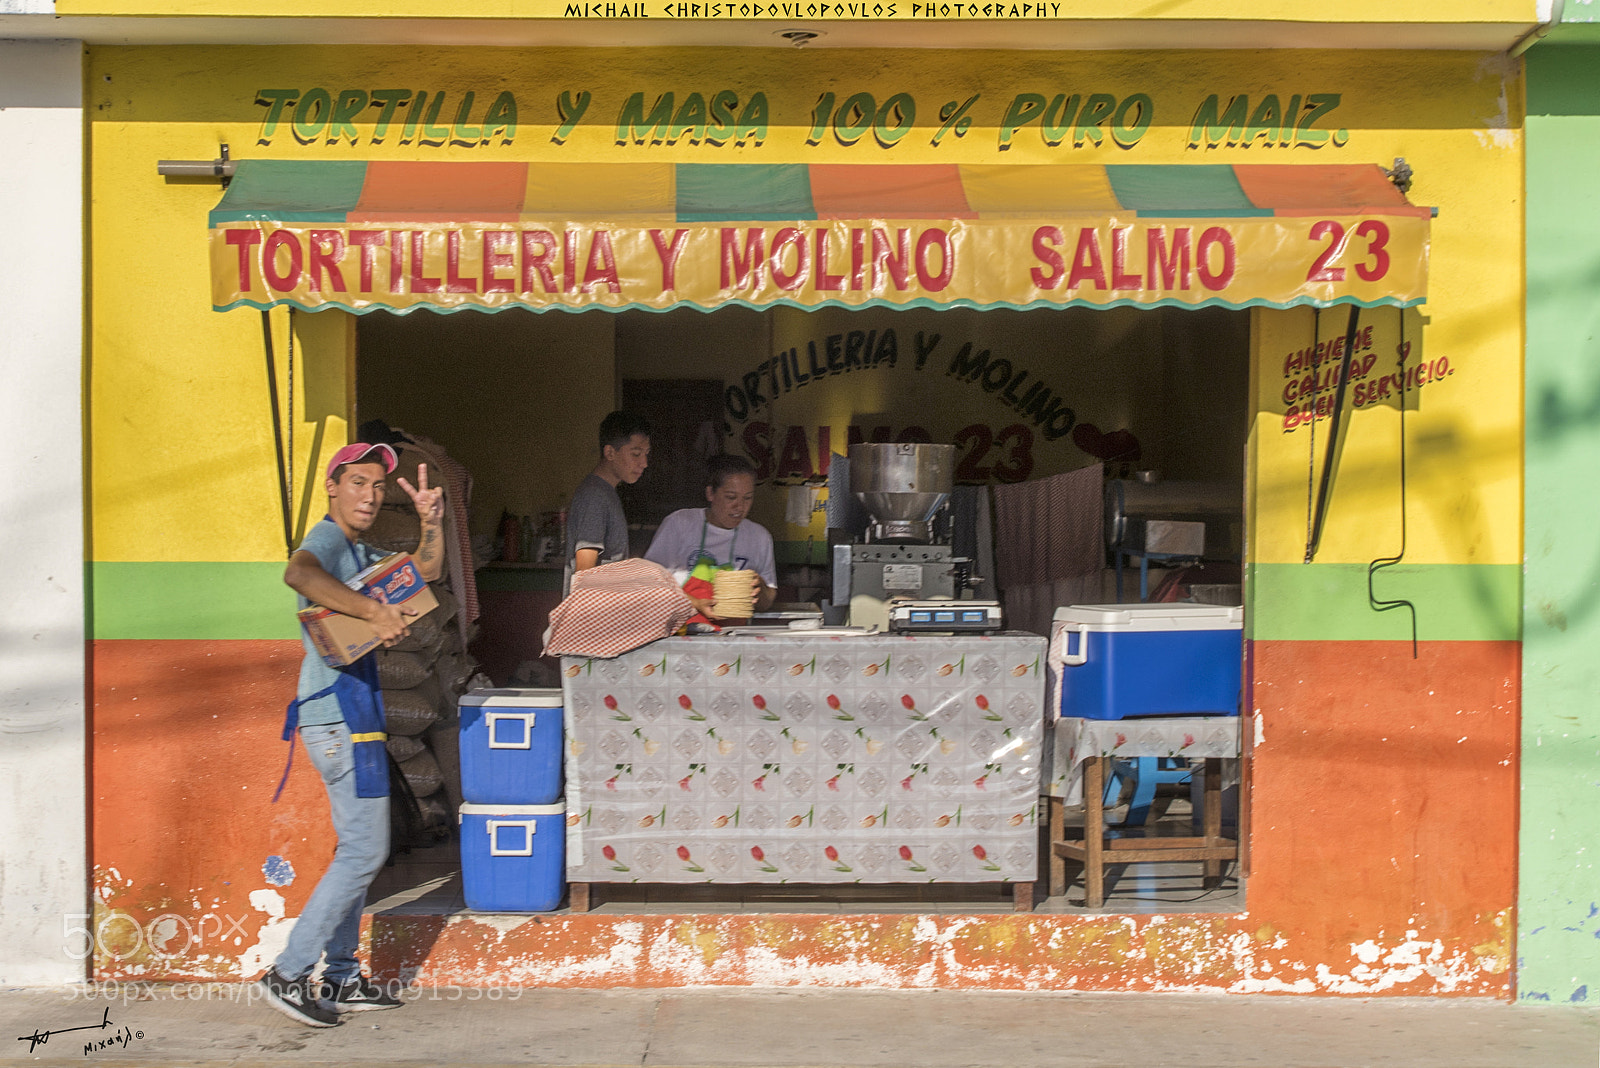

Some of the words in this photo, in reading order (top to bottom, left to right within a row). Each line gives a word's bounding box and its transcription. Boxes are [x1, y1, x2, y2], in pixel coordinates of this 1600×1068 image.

[255, 88, 519, 147] TORTILLA
[551, 90, 592, 145] Y
[615, 91, 770, 147] MASA
[806, 91, 916, 149] 100
[929, 93, 981, 147] %
[999, 93, 1154, 151] PURO
[1187, 94, 1350, 151] MAIZ.
[225, 228, 622, 295] TORTILLERIA
[649, 228, 690, 294] Y
[719, 227, 955, 293] MOLINO
[1030, 226, 1237, 292] SALMO
[1306, 219, 1391, 283] 23
[724, 328, 898, 434] ORTILLERIA
[914, 329, 942, 370] Y
[945, 341, 1075, 441] MOLINO
[954, 423, 1035, 484] 23
